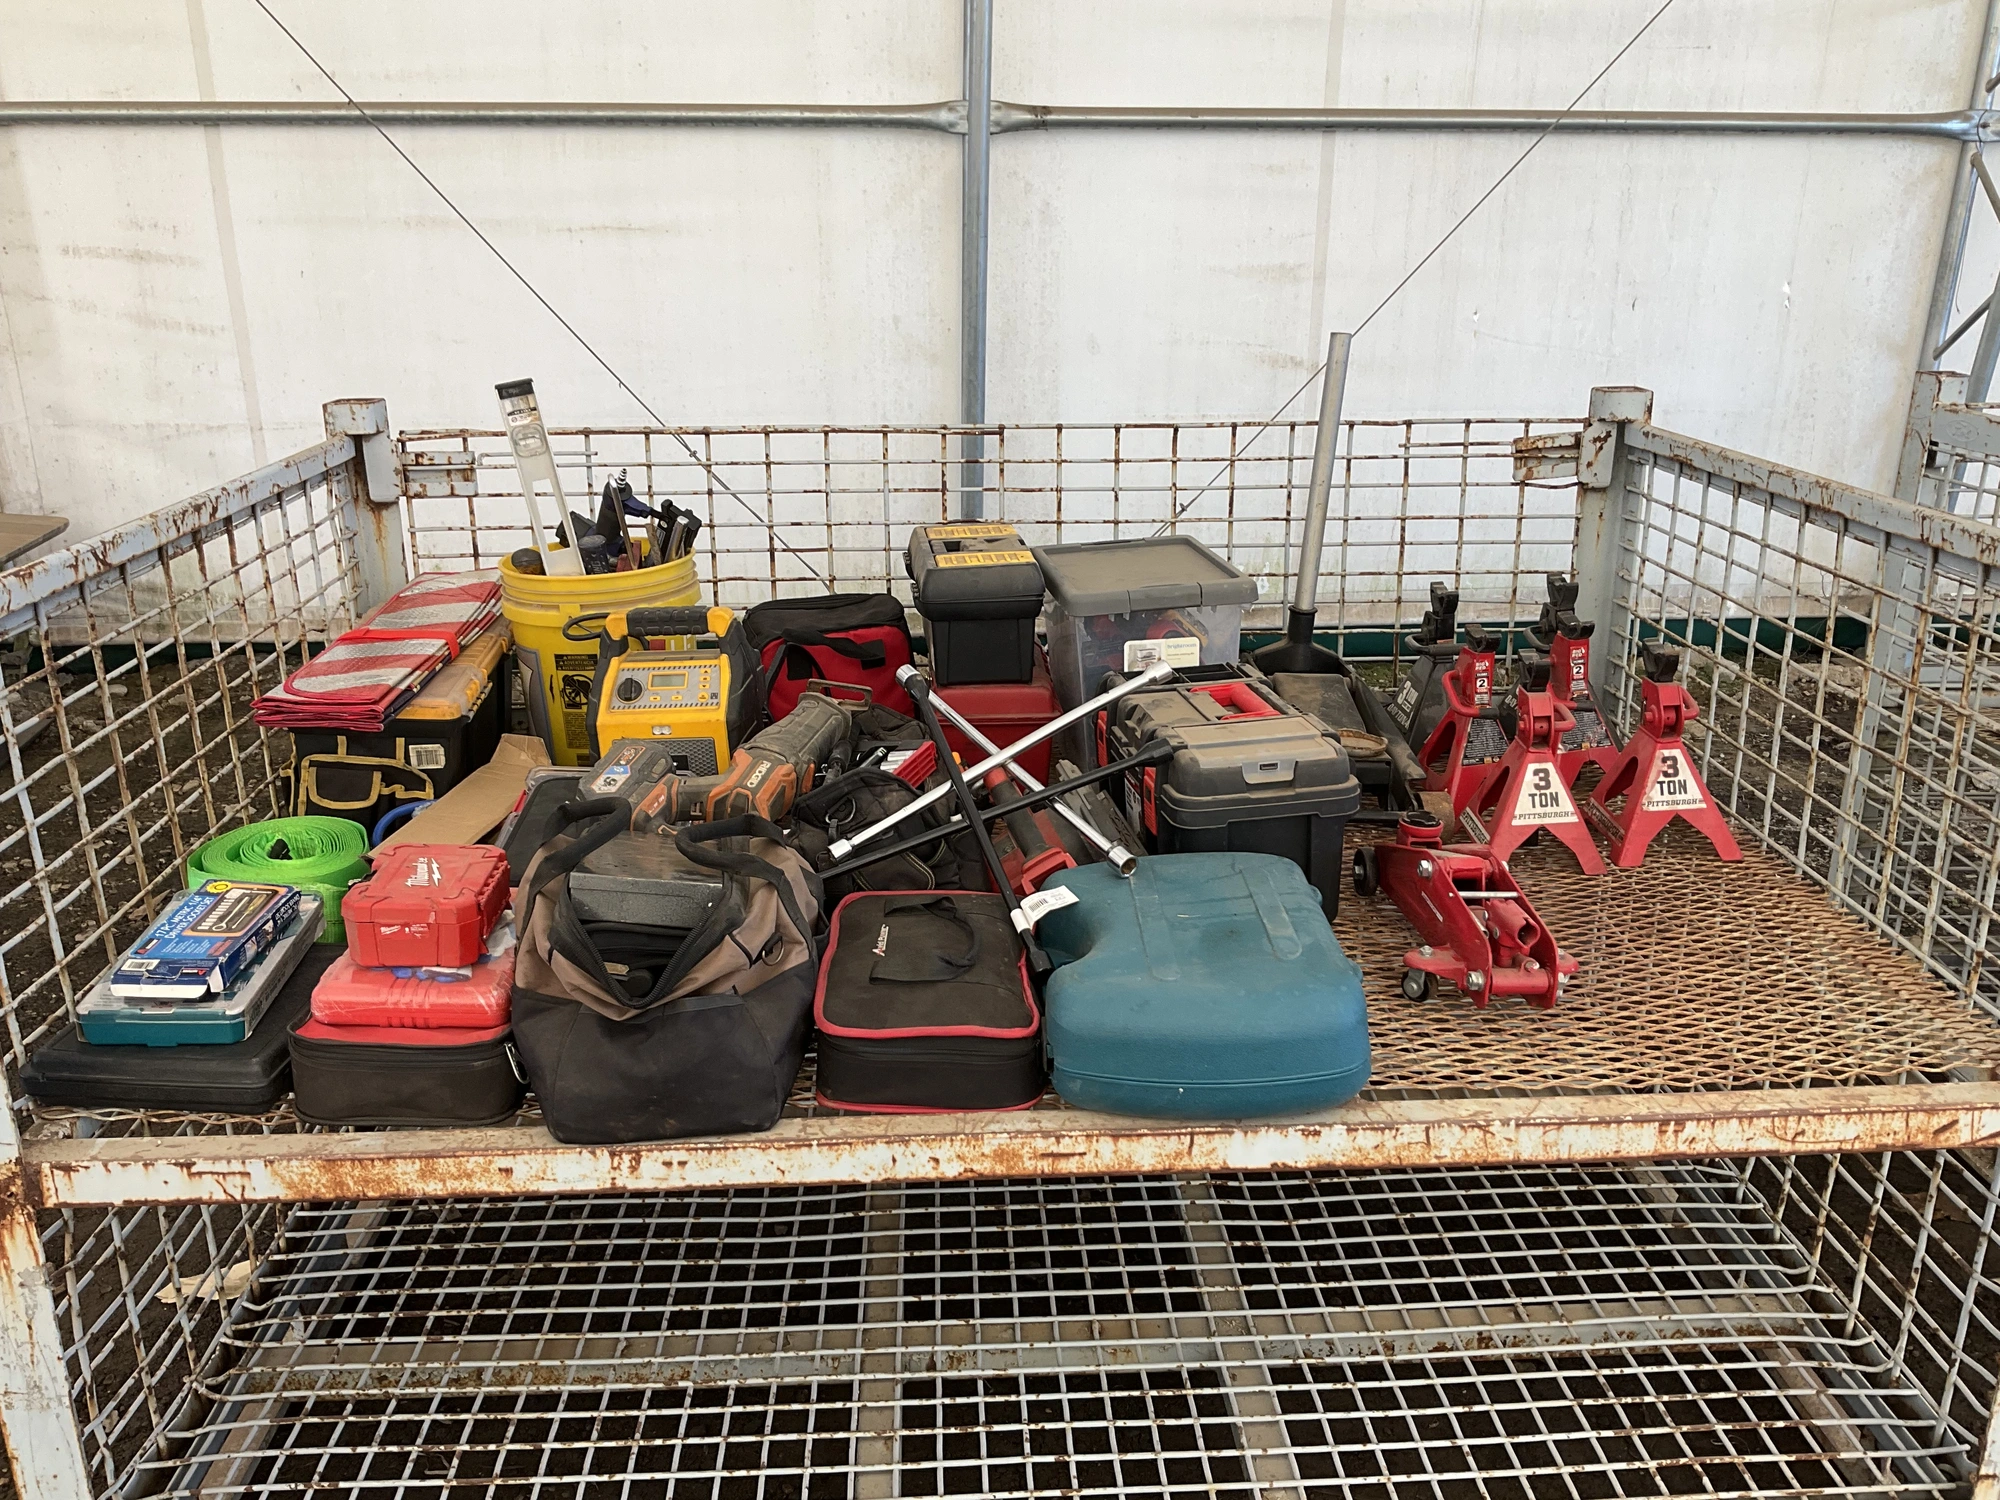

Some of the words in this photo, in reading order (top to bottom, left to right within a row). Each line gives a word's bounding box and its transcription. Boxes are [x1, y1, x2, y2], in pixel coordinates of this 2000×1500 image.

[1575, 666, 1582, 674] 2
[1397, 680, 1411, 705] 3
[1479, 679, 1486, 687] 2
[746, 760, 772, 788] RIDGID
[1661, 755, 1680, 778] 3
[1532, 768, 1551, 791] 3
[1656, 779, 1688, 796] TON
[1528, 792, 1560, 808] TON
[1646, 798, 1698, 807] PITTSBURGH
[1518, 811, 1570, 820] PITTSBURGH
[155, 929, 167, 937] 17
[170, 905, 194, 923] METRIC
[164, 922, 189, 939] DRIVER
[182, 904, 207, 922] SOCKET
[200, 896, 214, 905] SET
